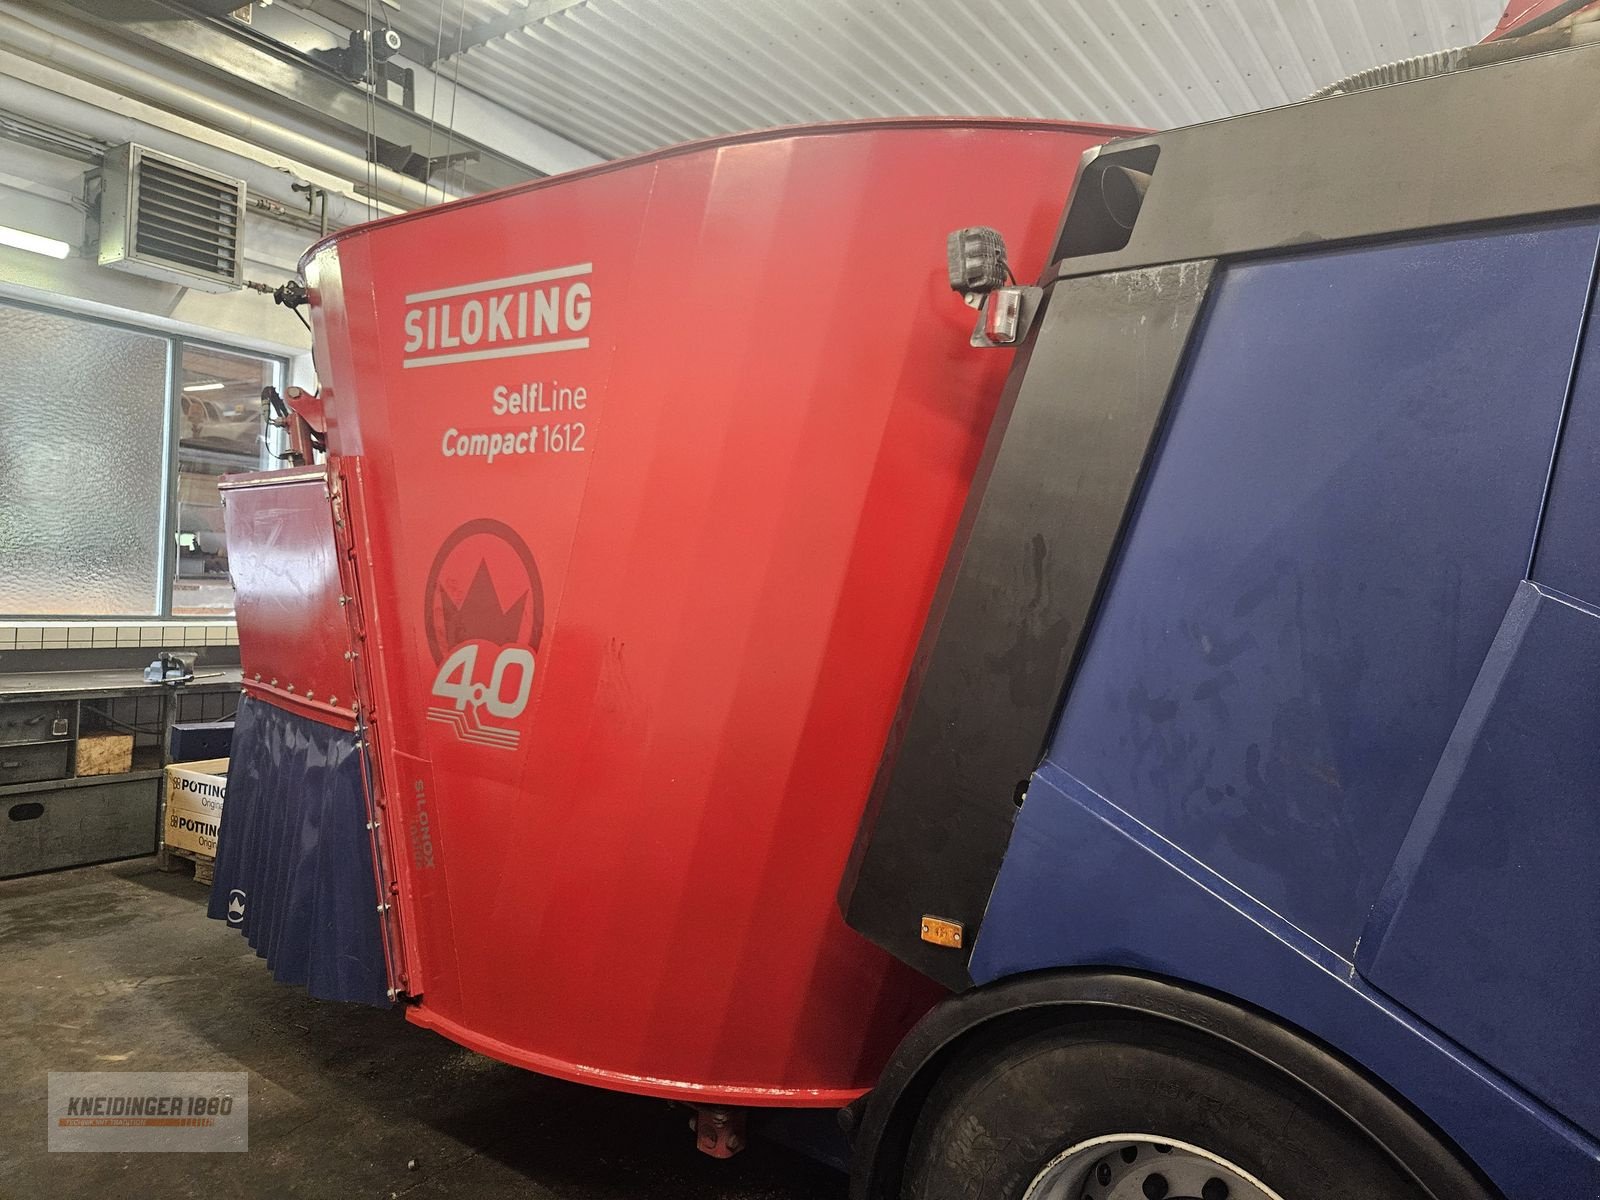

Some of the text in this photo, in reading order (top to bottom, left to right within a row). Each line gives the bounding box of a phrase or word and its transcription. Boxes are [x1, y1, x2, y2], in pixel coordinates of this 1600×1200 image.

[404, 283, 591, 353] SILOKING
[492, 381, 587, 415] SelfLine
[442, 422, 586, 463] Compact 1612
[415, 779, 436, 869] SILONOX
